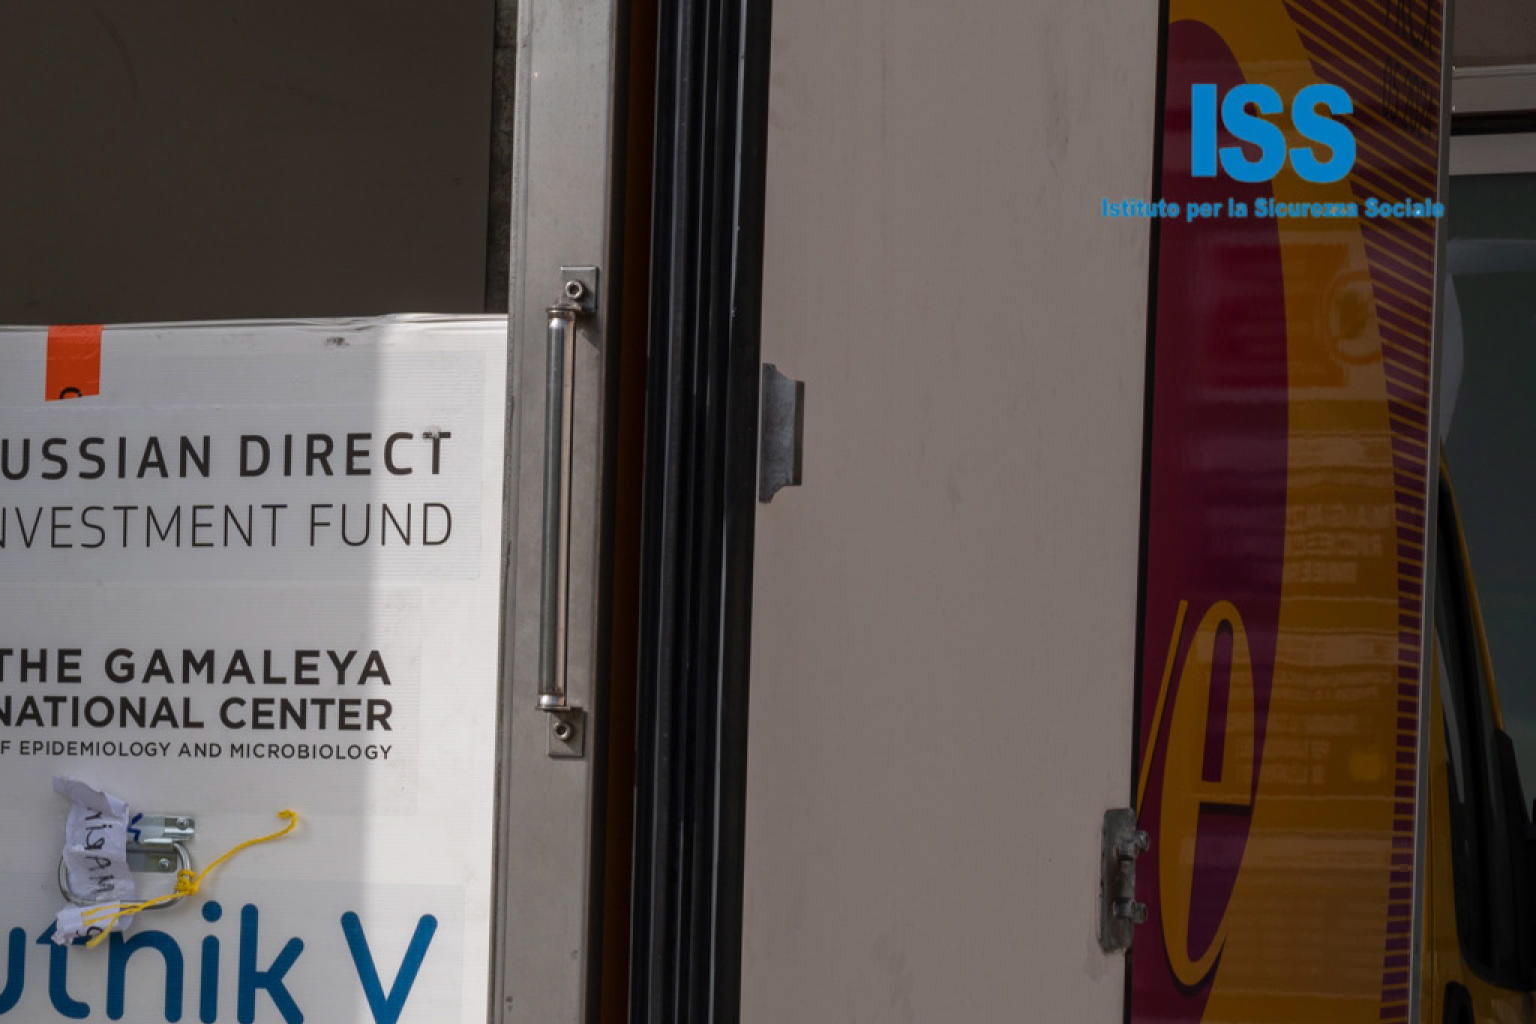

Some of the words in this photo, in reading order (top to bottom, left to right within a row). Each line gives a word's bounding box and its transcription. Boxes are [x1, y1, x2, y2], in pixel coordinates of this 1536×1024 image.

[240, 432, 451, 476] DIRECT
[311, 503, 452, 546] FUND
[105, 649, 390, 685] GAMALEYA
[220, 697, 392, 731] CENTER
[20, 741, 170, 756] EPIDEMIOLOGY
[179, 743, 221, 757] AND
[231, 744, 391, 759] MICROBIOLOGY
